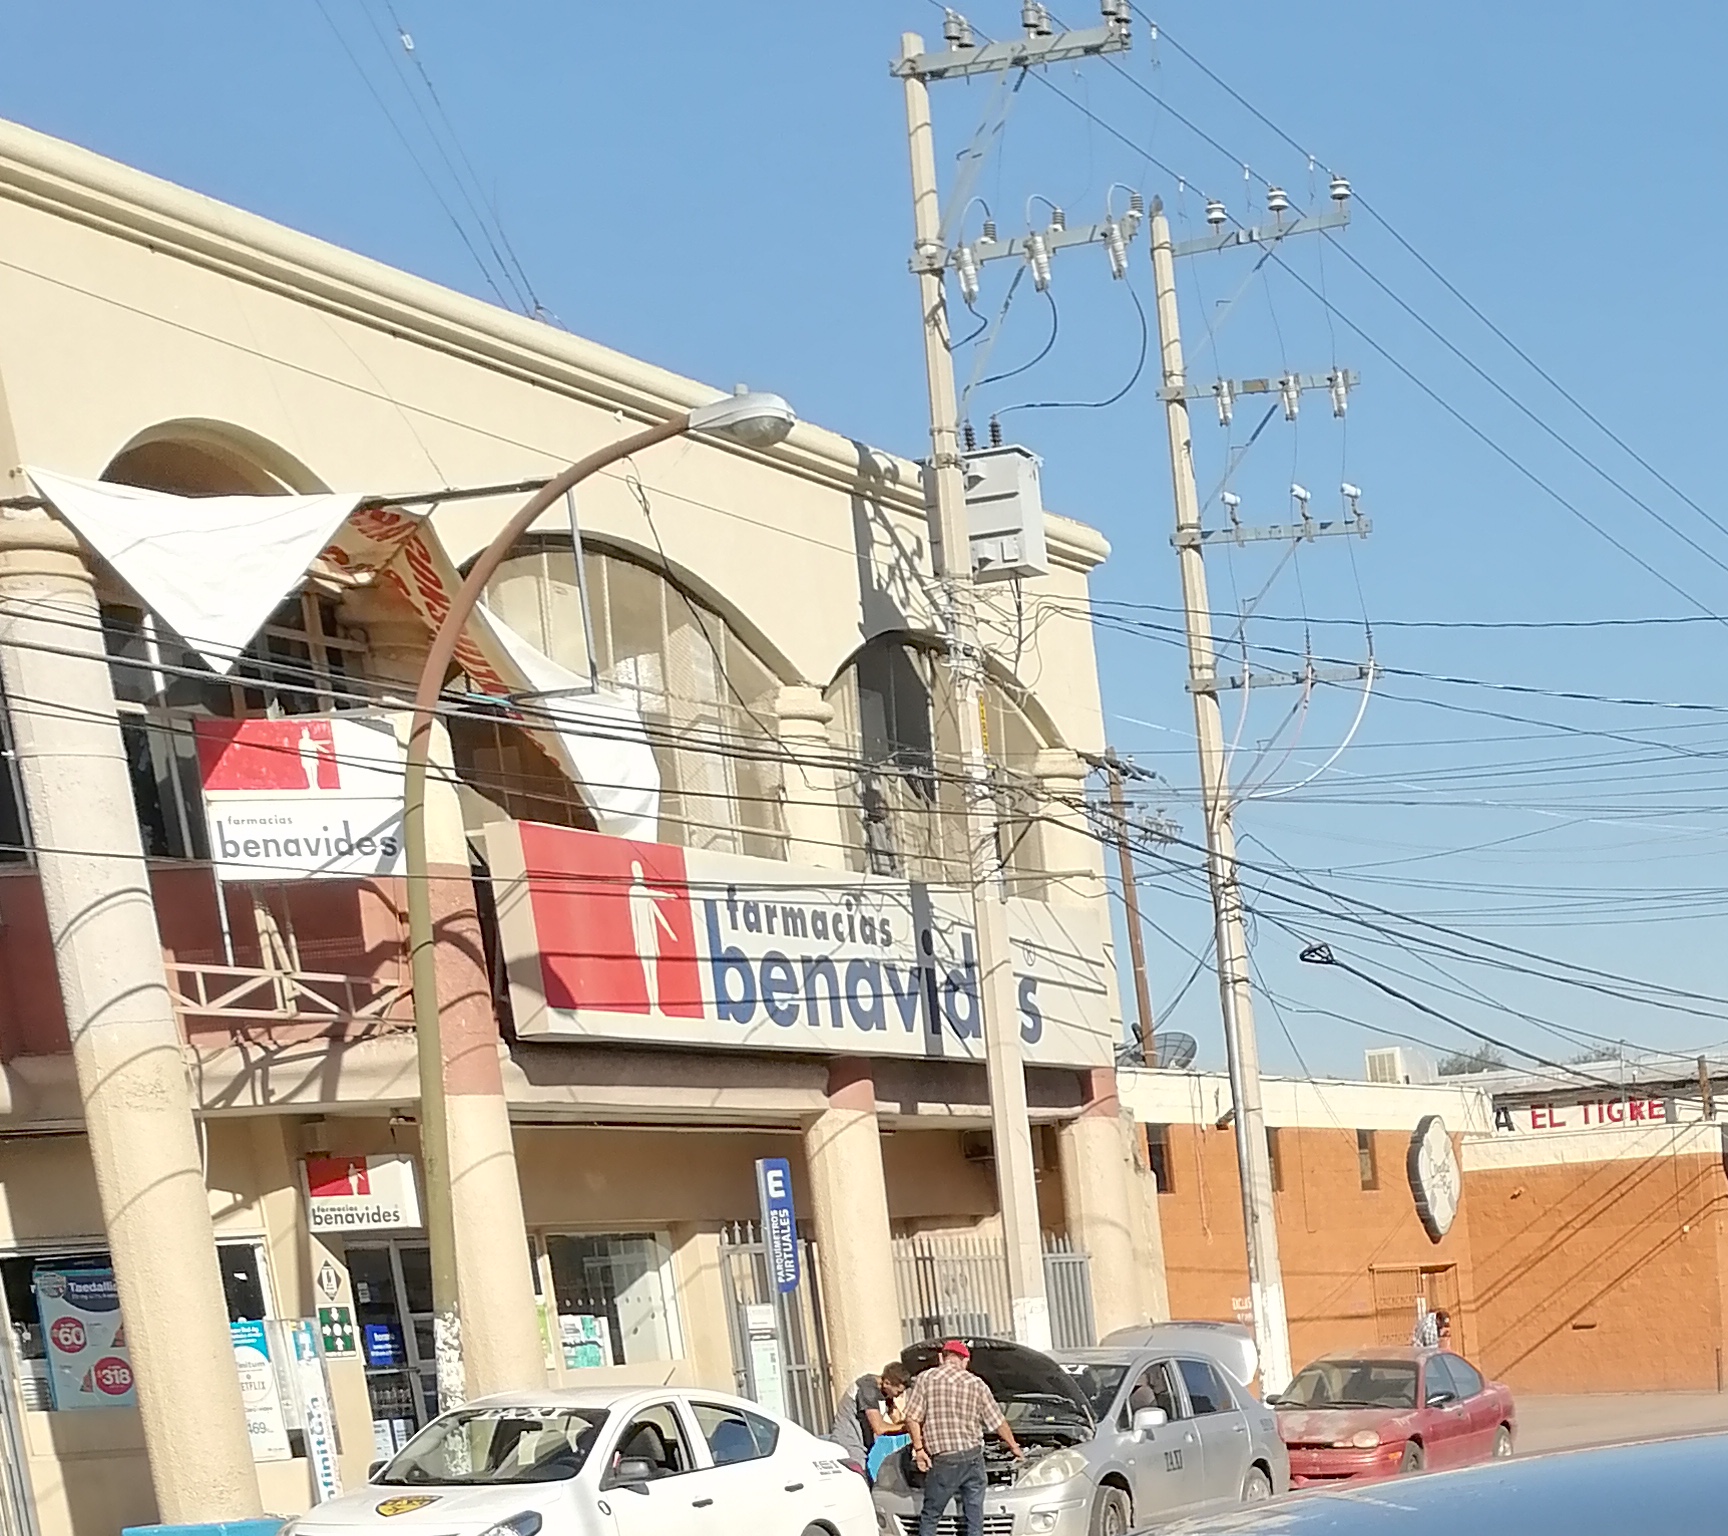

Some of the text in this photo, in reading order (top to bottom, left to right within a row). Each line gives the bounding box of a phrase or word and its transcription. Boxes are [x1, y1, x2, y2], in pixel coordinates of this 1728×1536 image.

[227, 814, 294, 825] farmacias
[216, 820, 398, 859] benavides
[726, 886, 894, 948] farmacias
[704, 898, 1043, 1045] benavids
[1530, 1103, 1566, 1130] EL
[1577, 1096, 1666, 1125] TIGRE
[312, 1205, 401, 1226] benavides
[770, 1209, 786, 1284] PARQUIMETROS
[778, 1208, 796, 1283] VIRTUALES
[239, 1381, 266, 1392] ETFLIX
